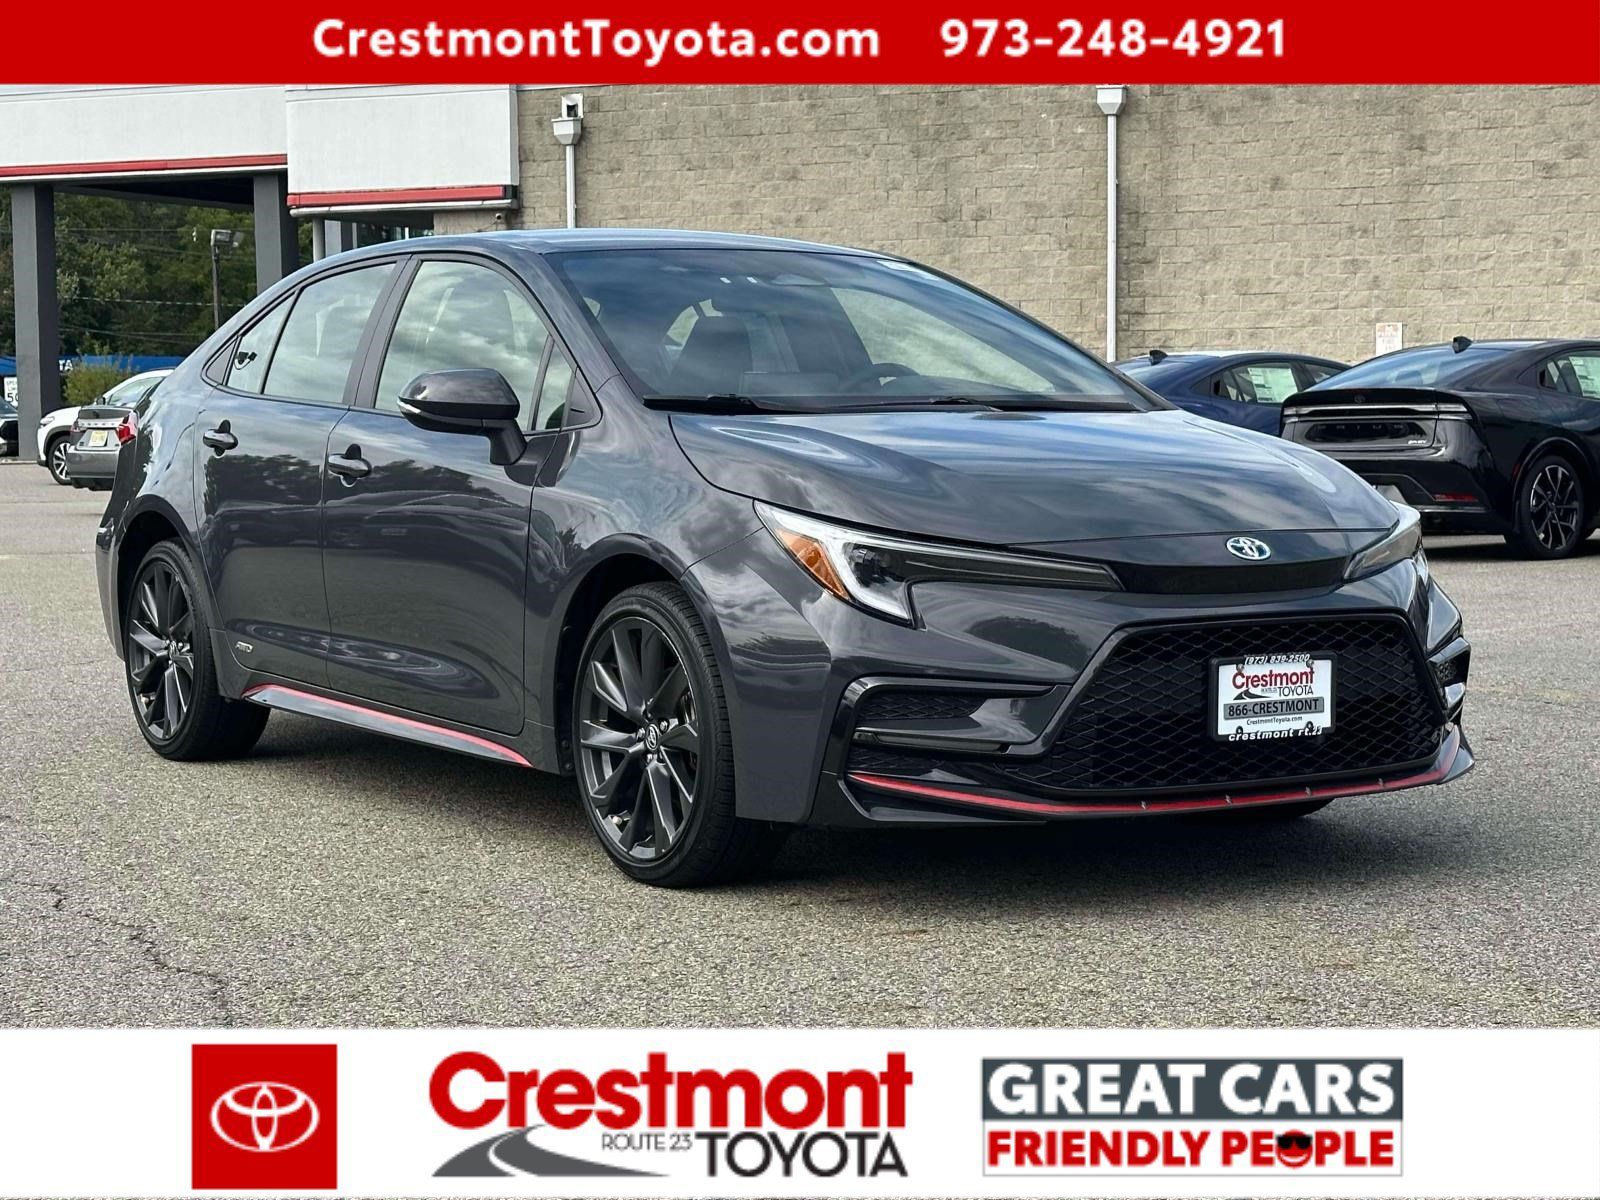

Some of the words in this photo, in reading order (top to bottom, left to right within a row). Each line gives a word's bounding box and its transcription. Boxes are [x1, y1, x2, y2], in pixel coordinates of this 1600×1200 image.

[1232, 666, 1315, 690] Crestmont
[1278, 684, 1313, 697] TOYOTA
[1228, 699, 1319, 716] 866-CRESTMONT
[1228, 728, 1294, 742] crestmont
